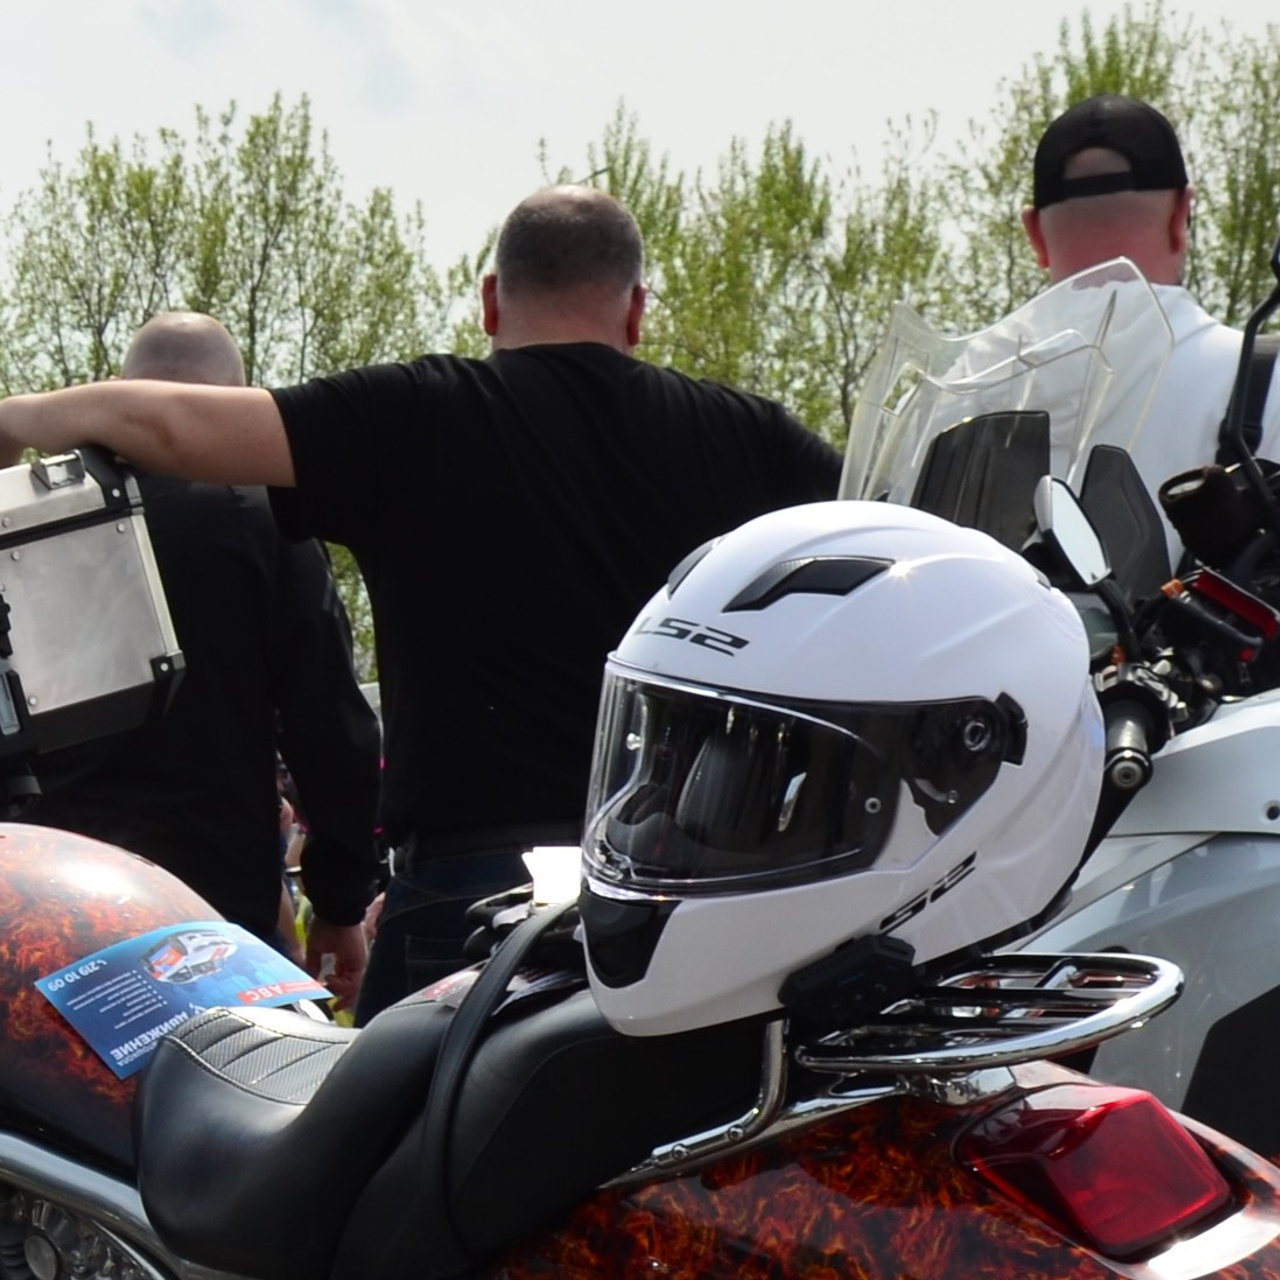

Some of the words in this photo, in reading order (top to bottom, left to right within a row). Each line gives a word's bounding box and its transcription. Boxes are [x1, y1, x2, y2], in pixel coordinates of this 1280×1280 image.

[633, 616, 750, 657] LS2
[879, 850, 977, 936] S2
[63, 971, 81, 984] 10
[78, 960, 100, 976] 219
